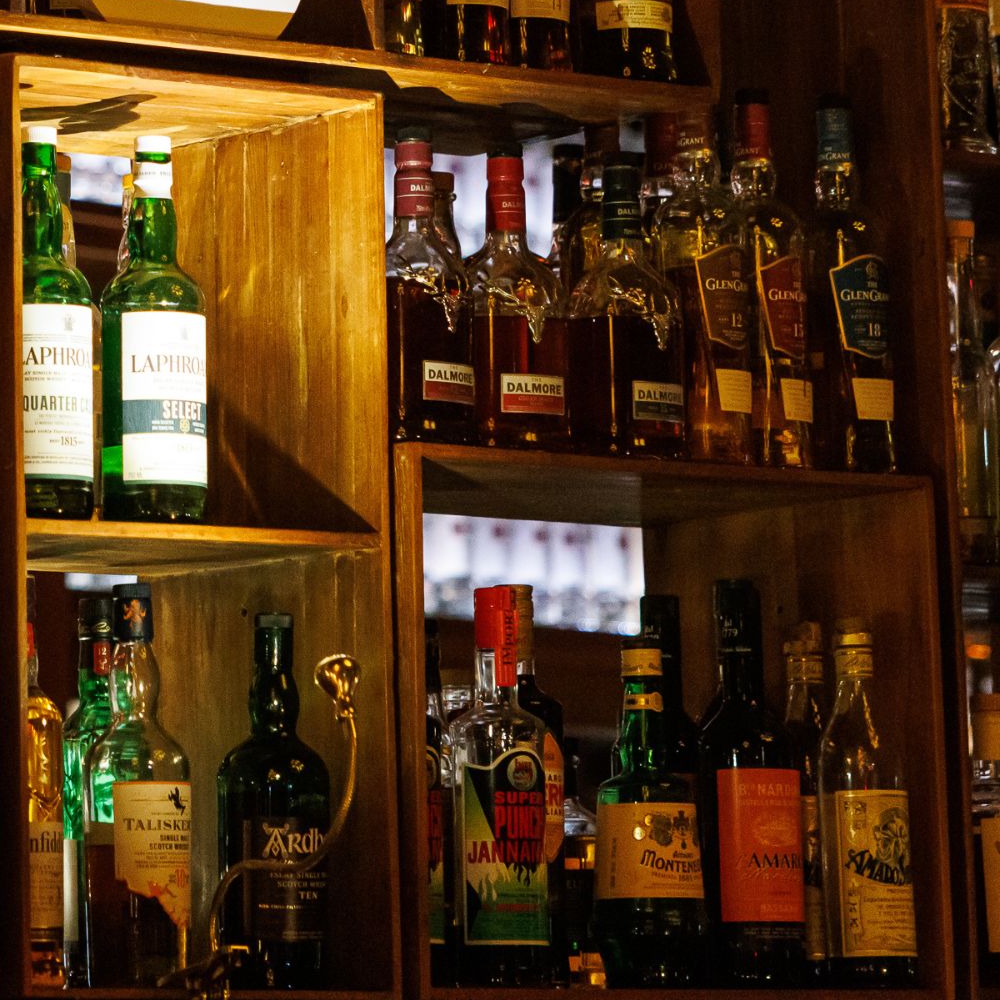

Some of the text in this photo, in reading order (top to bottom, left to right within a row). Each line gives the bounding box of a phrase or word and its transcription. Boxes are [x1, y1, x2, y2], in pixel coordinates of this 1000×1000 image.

[731, 312, 744, 328] 12
[868, 322, 881, 337] 18
[23, 346, 92, 369] APHROA
[428, 369, 473, 384] DALMORE
[507, 382, 562, 395] DALMORE
[23, 394, 78, 413] QUARTER
[162, 400, 202, 421] SELECT
[60, 435, 78, 447] 1815
[277, 880, 308, 888] SCOTCH
[298, 890, 319, 901] TEN
